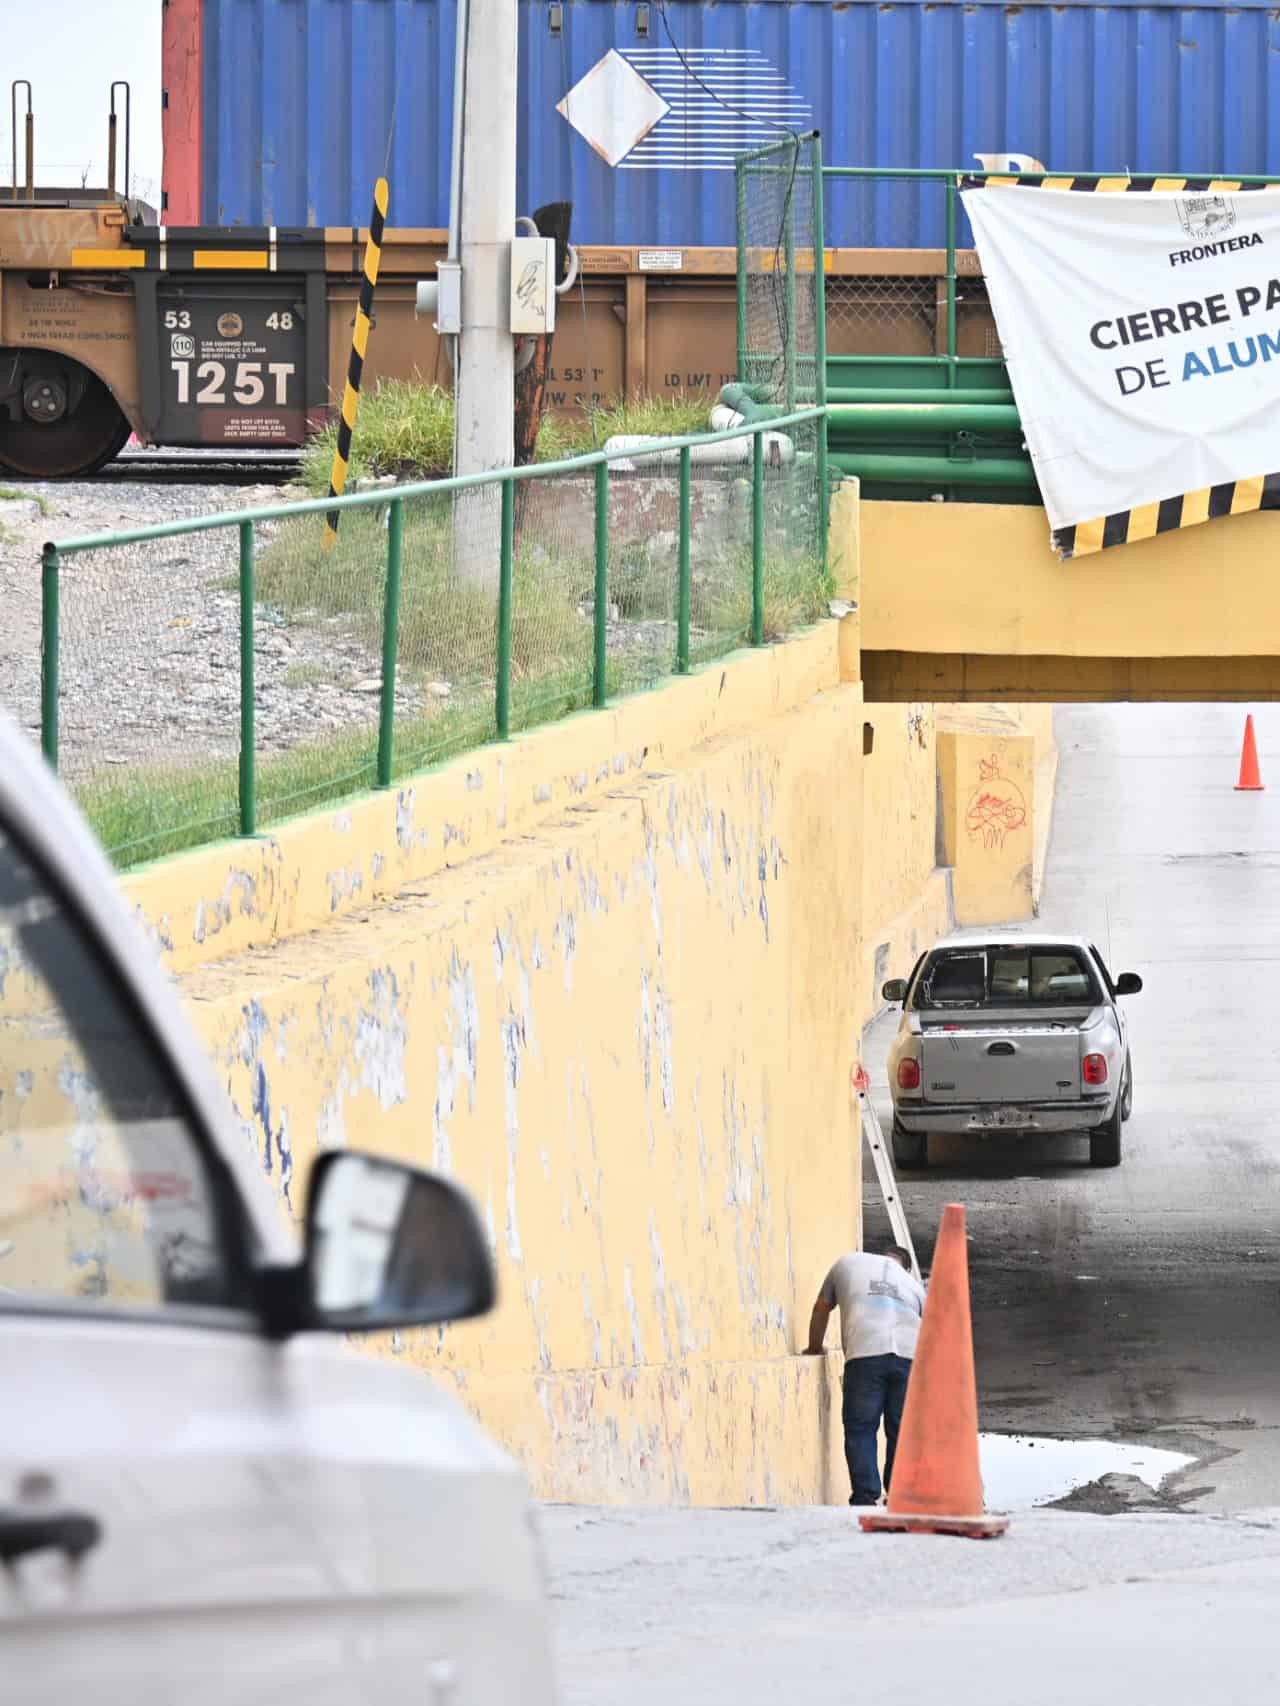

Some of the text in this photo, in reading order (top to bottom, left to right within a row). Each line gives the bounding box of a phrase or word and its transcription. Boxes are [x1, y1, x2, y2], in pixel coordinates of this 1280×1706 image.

[1168, 231, 1265, 268] FRONTERA
[164, 310, 293, 331] 53 48
[1089, 293, 1231, 350] CIERRE
[174, 340, 192, 352] 110
[171, 360, 296, 405] 125T
[1114, 358, 1171, 396] DE
